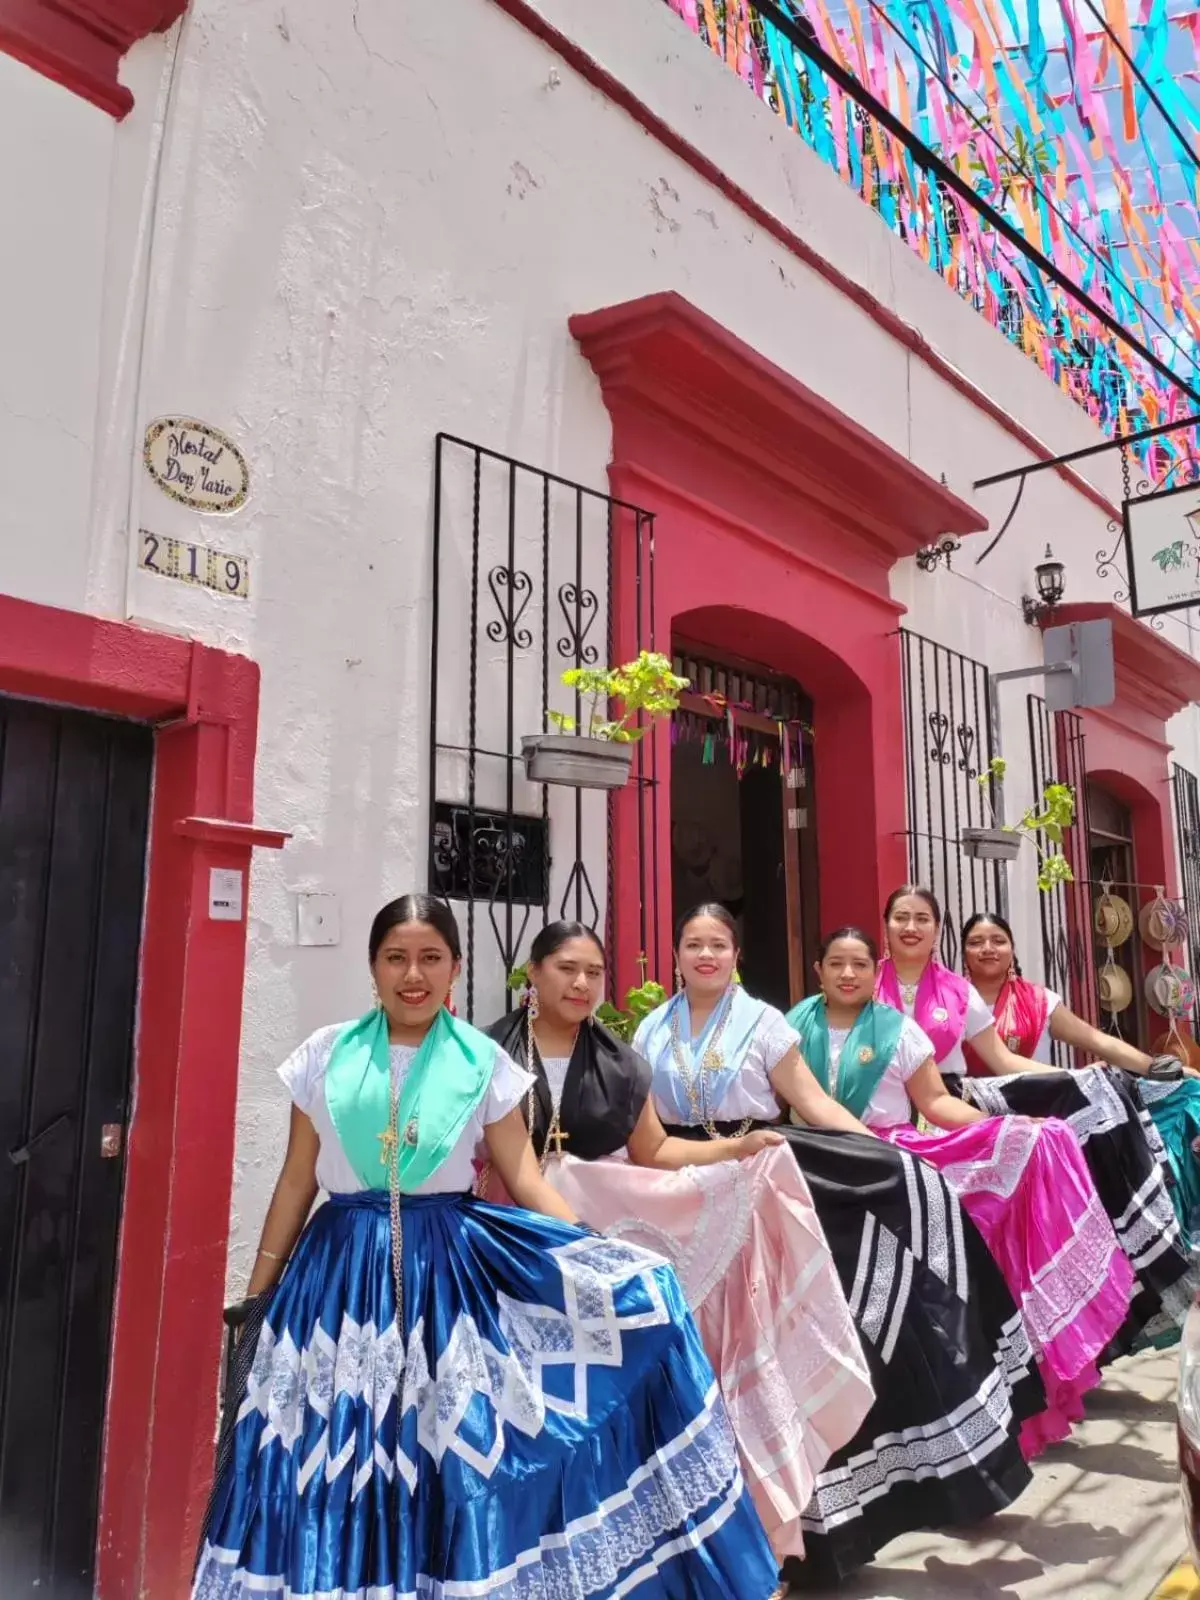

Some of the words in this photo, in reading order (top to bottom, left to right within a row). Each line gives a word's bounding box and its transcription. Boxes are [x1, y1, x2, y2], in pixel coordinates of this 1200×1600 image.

[168, 431, 223, 464] Hostal
[162, 457, 194, 486] Don
[144, 536, 240, 591] 219
